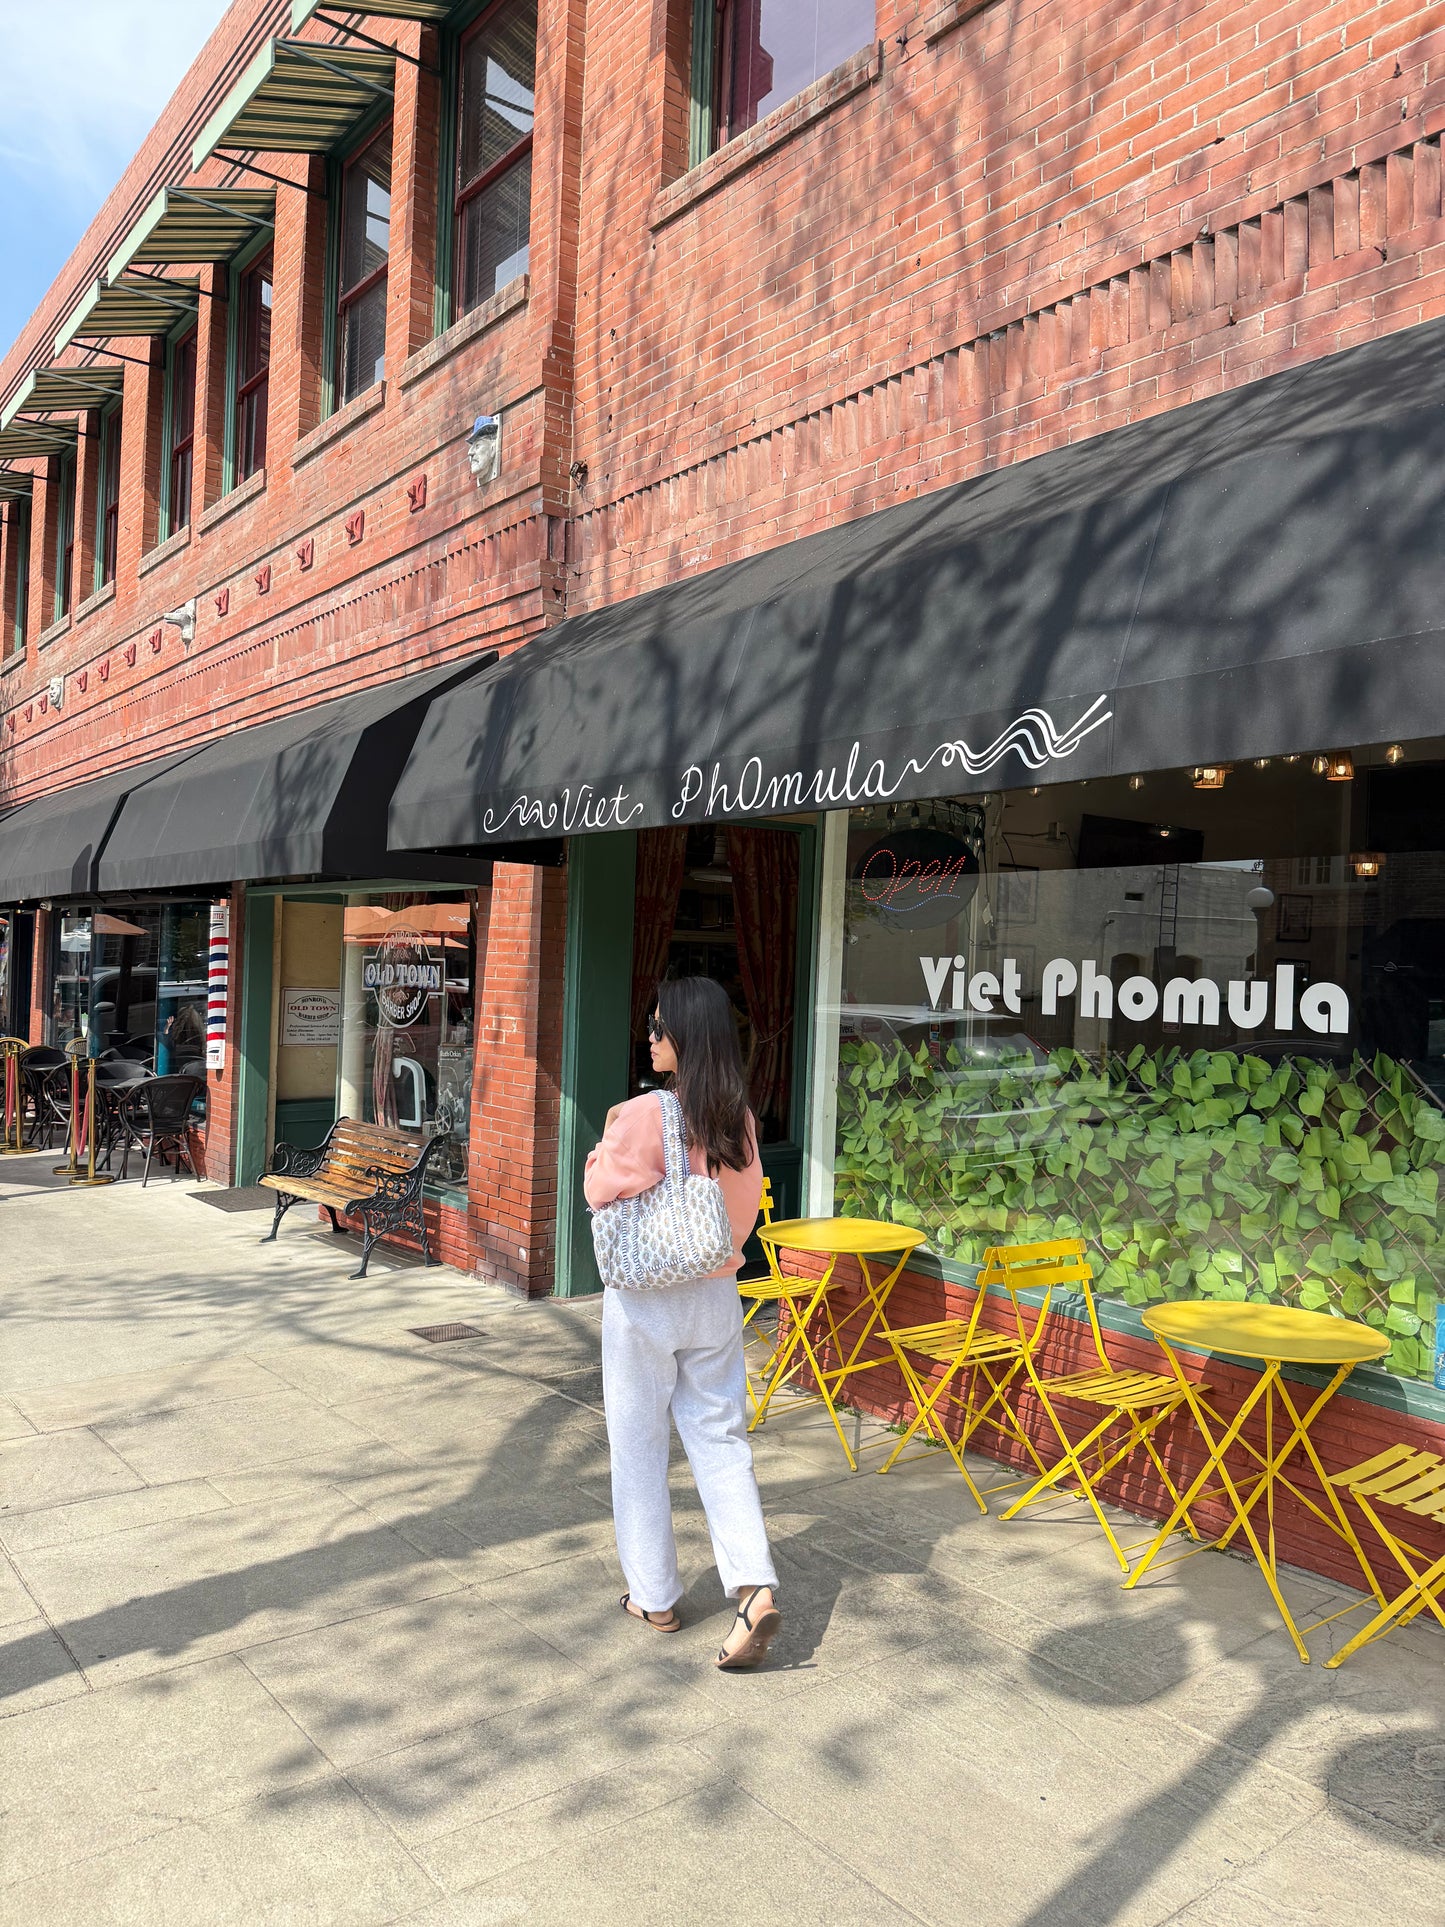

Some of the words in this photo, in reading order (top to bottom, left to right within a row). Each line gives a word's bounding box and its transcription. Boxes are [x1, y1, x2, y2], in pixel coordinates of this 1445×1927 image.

[560, 784, 643, 831] Viet
[861, 849, 966, 905] Open
[364, 963, 395, 987] OLD
[396, 964, 441, 989] TOWN
[919, 954, 1022, 1014] Viet
[1041, 957, 1350, 1034] Phomula
[381, 990, 405, 1019] BARBER
[406, 990, 422, 1017] SHOP
